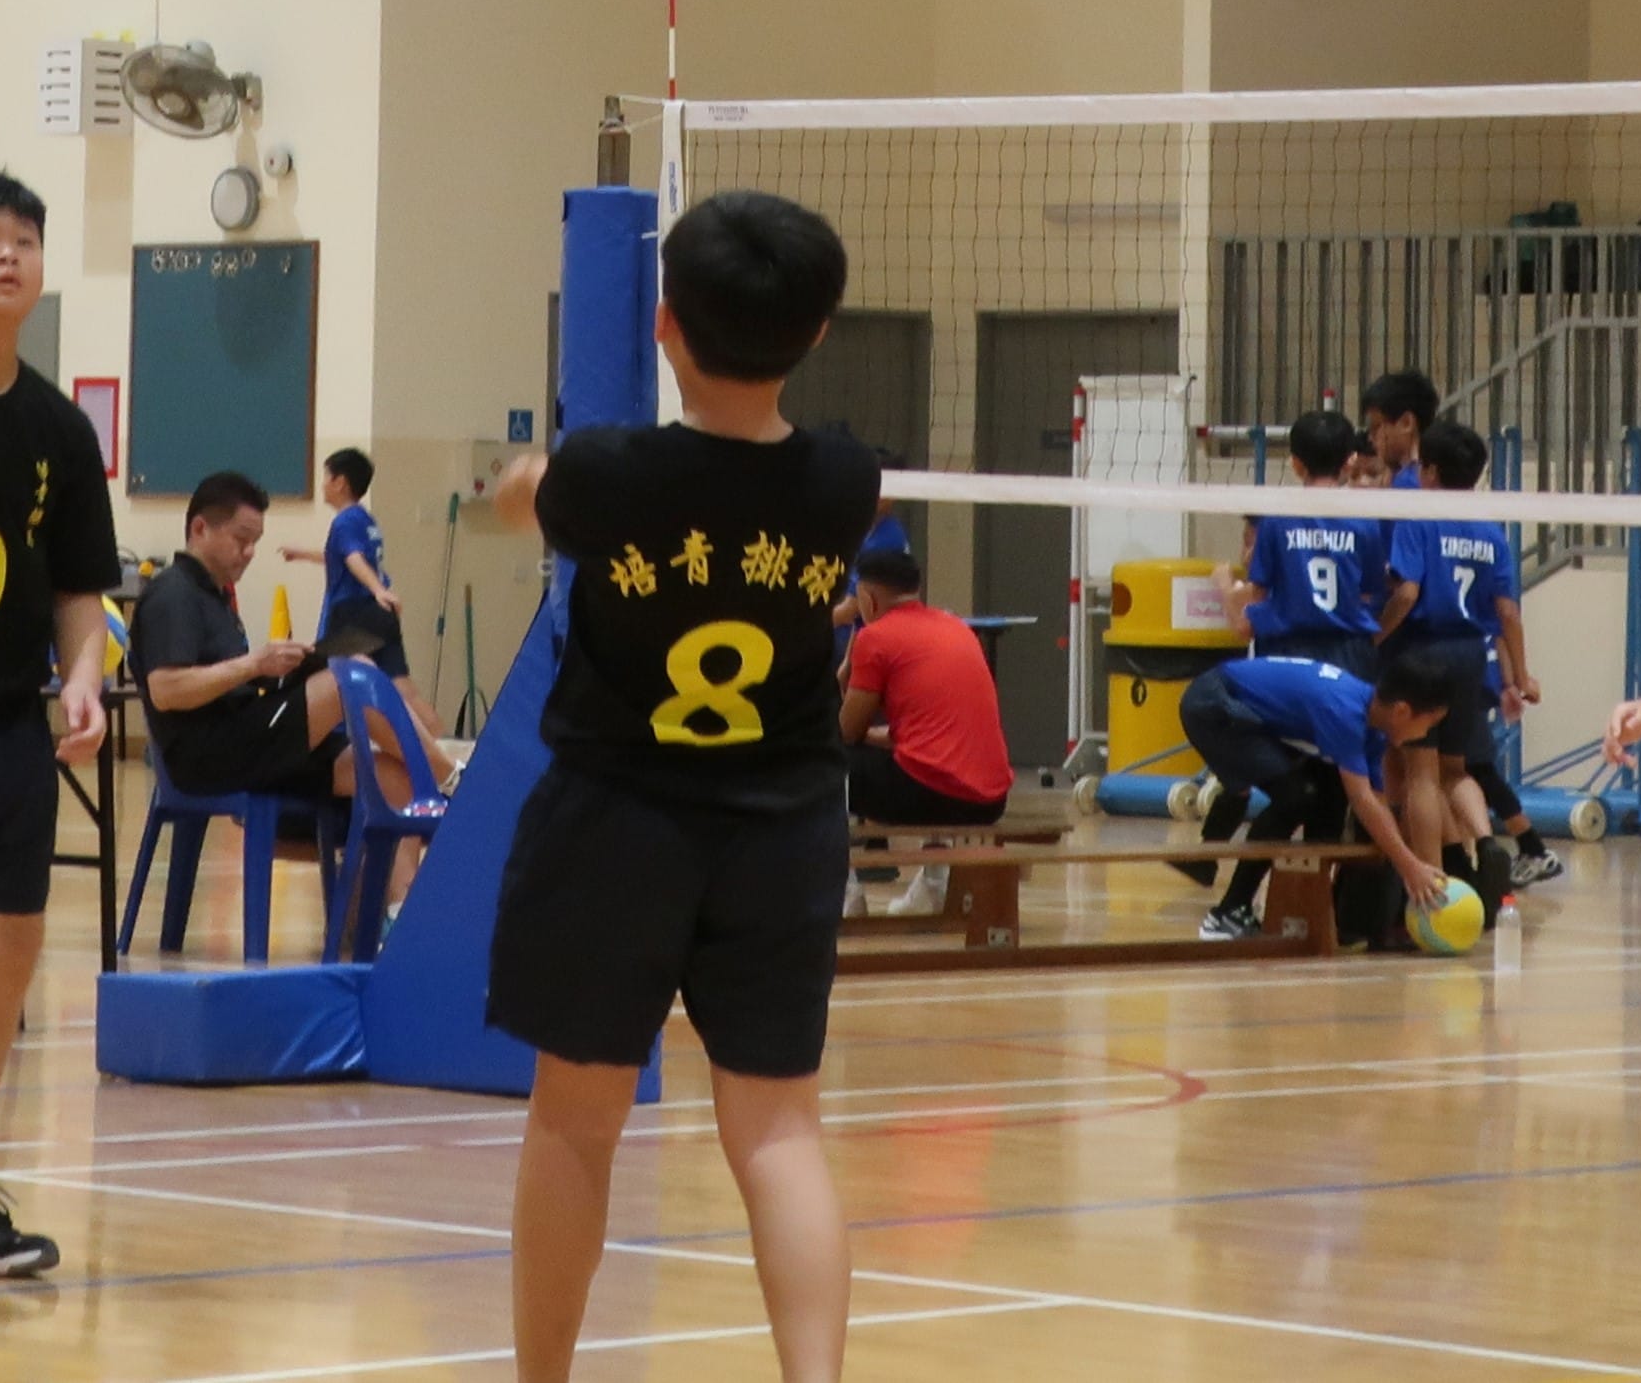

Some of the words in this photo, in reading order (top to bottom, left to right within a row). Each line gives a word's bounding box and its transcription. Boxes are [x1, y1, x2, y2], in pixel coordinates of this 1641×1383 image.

[1285, 528, 1355, 554] XINGHUA
[1440, 535, 1495, 564] XINGHUA
[1307, 556, 1338, 613] 9
[1453, 565, 1476, 619] 7
[649, 620, 775, 747] 8
